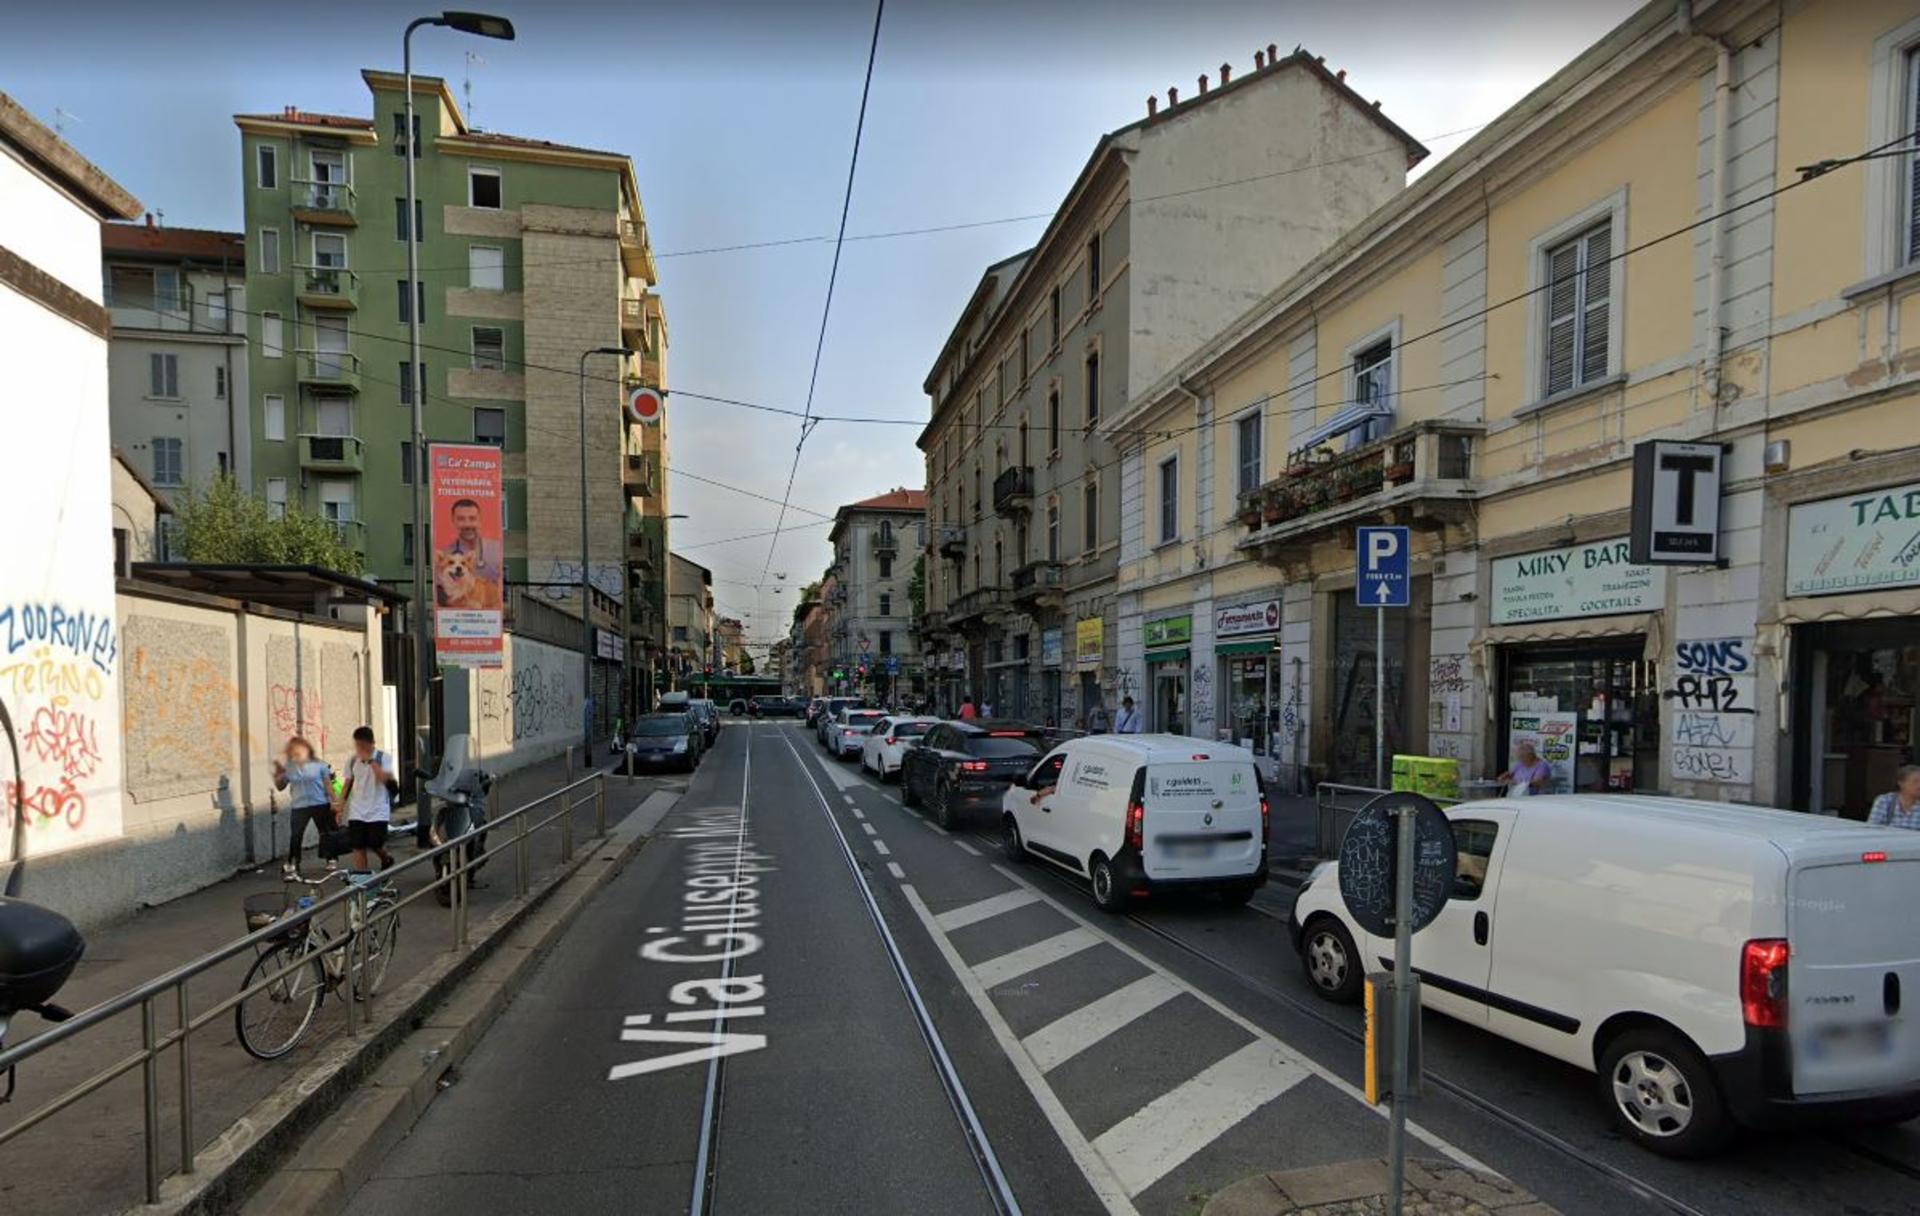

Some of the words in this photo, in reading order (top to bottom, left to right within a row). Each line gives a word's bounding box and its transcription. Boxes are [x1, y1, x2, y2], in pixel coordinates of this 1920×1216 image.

[464, 458, 497, 470] Zampa
[1661, 452, 1715, 526] T
[1368, 532, 1398, 570] P
[1516, 550, 1573, 579] MIKY
[1584, 542, 1629, 570] BAR
[1580, 595, 1642, 613] COCKTAILS
[1676, 640, 1748, 675] SONS
